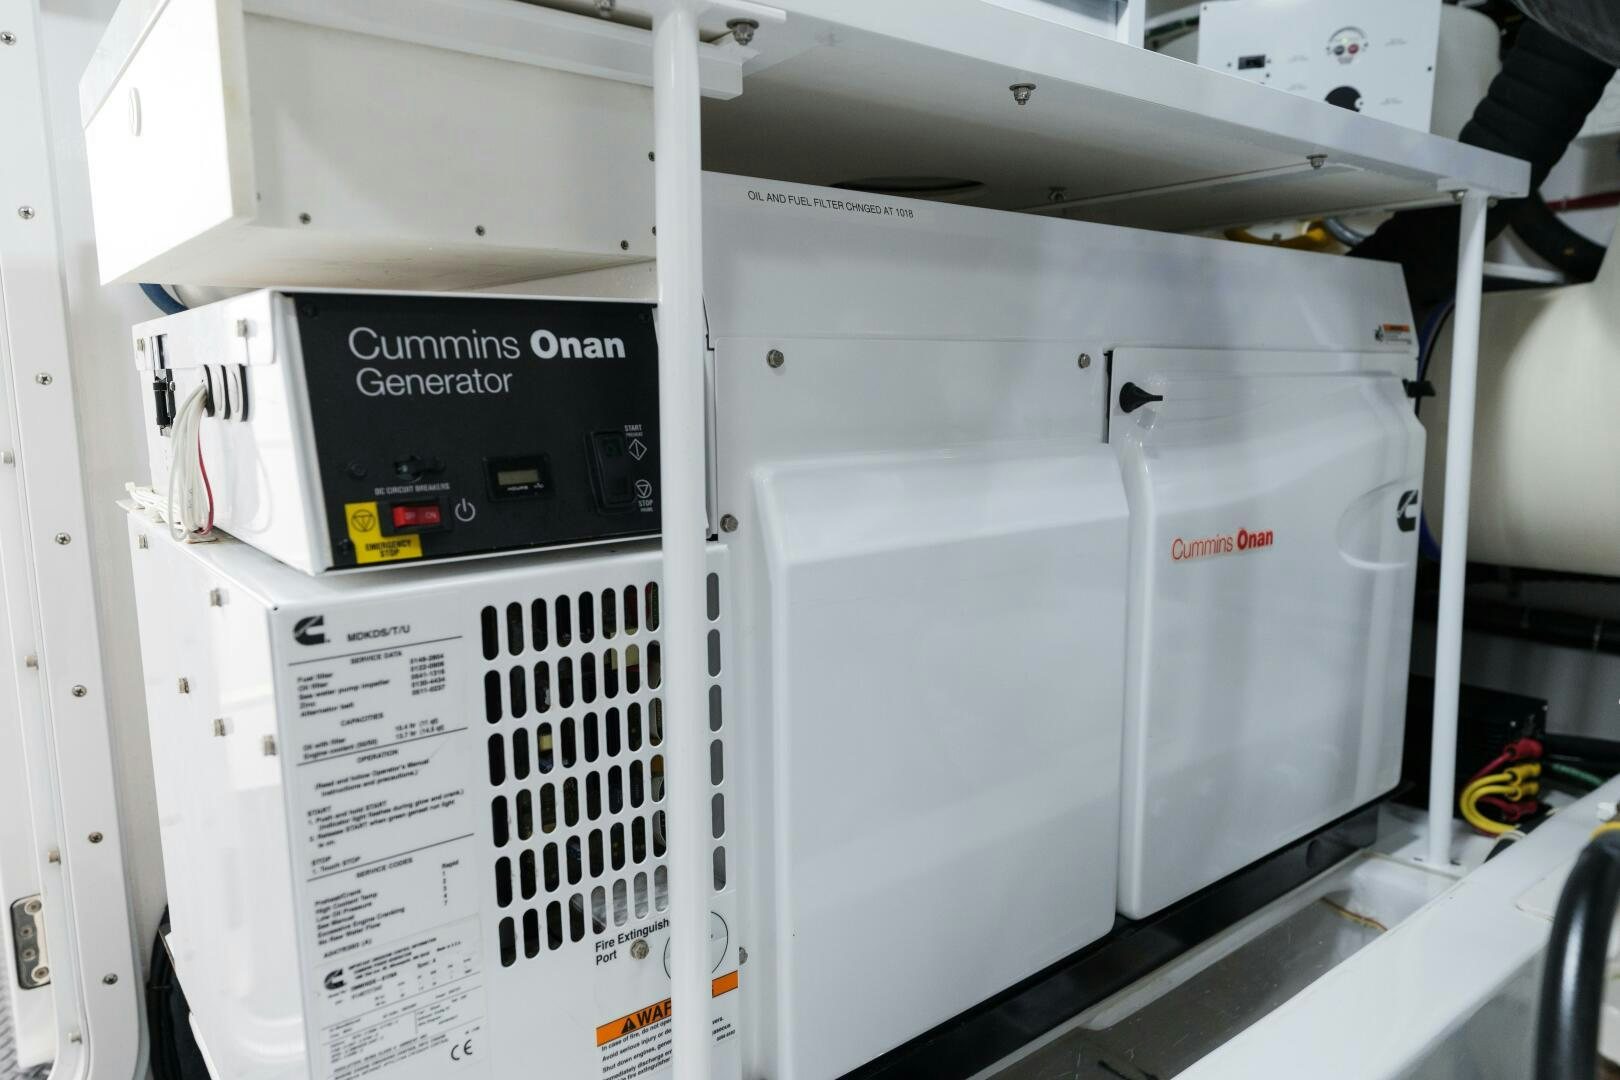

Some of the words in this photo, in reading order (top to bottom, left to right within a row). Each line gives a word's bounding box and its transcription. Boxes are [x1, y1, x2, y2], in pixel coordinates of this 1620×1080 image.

[747, 190, 764, 202] OIL
[766, 193, 787, 204] AND
[788, 196, 812, 207] FUEL
[814, 198, 844, 210] FILTER
[845, 202, 882, 215] CHNGED
[883, 207, 893, 216] AT
[895, 208, 914, 219] 1018
[348, 326, 521, 360] Cummins
[529, 329, 626, 359] Onan
[356, 367, 513, 397] Generator
[624, 424, 642, 432] START
[386, 485, 413, 495] CIRCUIT
[415, 482, 450, 492] BREAKERS
[365, 540, 412, 551] EMERGENCY
[1171, 534, 1233, 560] Cummins
[1236, 528, 1273, 551] Onan
[347, 625, 410, 642] MDKDS/T/U
[338, 685, 359, 694] pump
[595, 938, 615, 953] Fire
[596, 950, 617, 966] Port
[608, 1040, 622, 1048] case
[623, 1035, 629, 1043] of
[629, 1032, 640, 1040] fire,
[650, 1024, 659, 1032] not
[602, 1051, 618, 1062] Avoid
[620, 1042, 640, 1054] serious
[641, 1034, 656, 1046] injury
[603, 1063, 616, 1073] Shut
[617, 1057, 632, 1067] down
[633, 1047, 656, 1060] engines,
[637, 1053, 664, 1068] discharge
